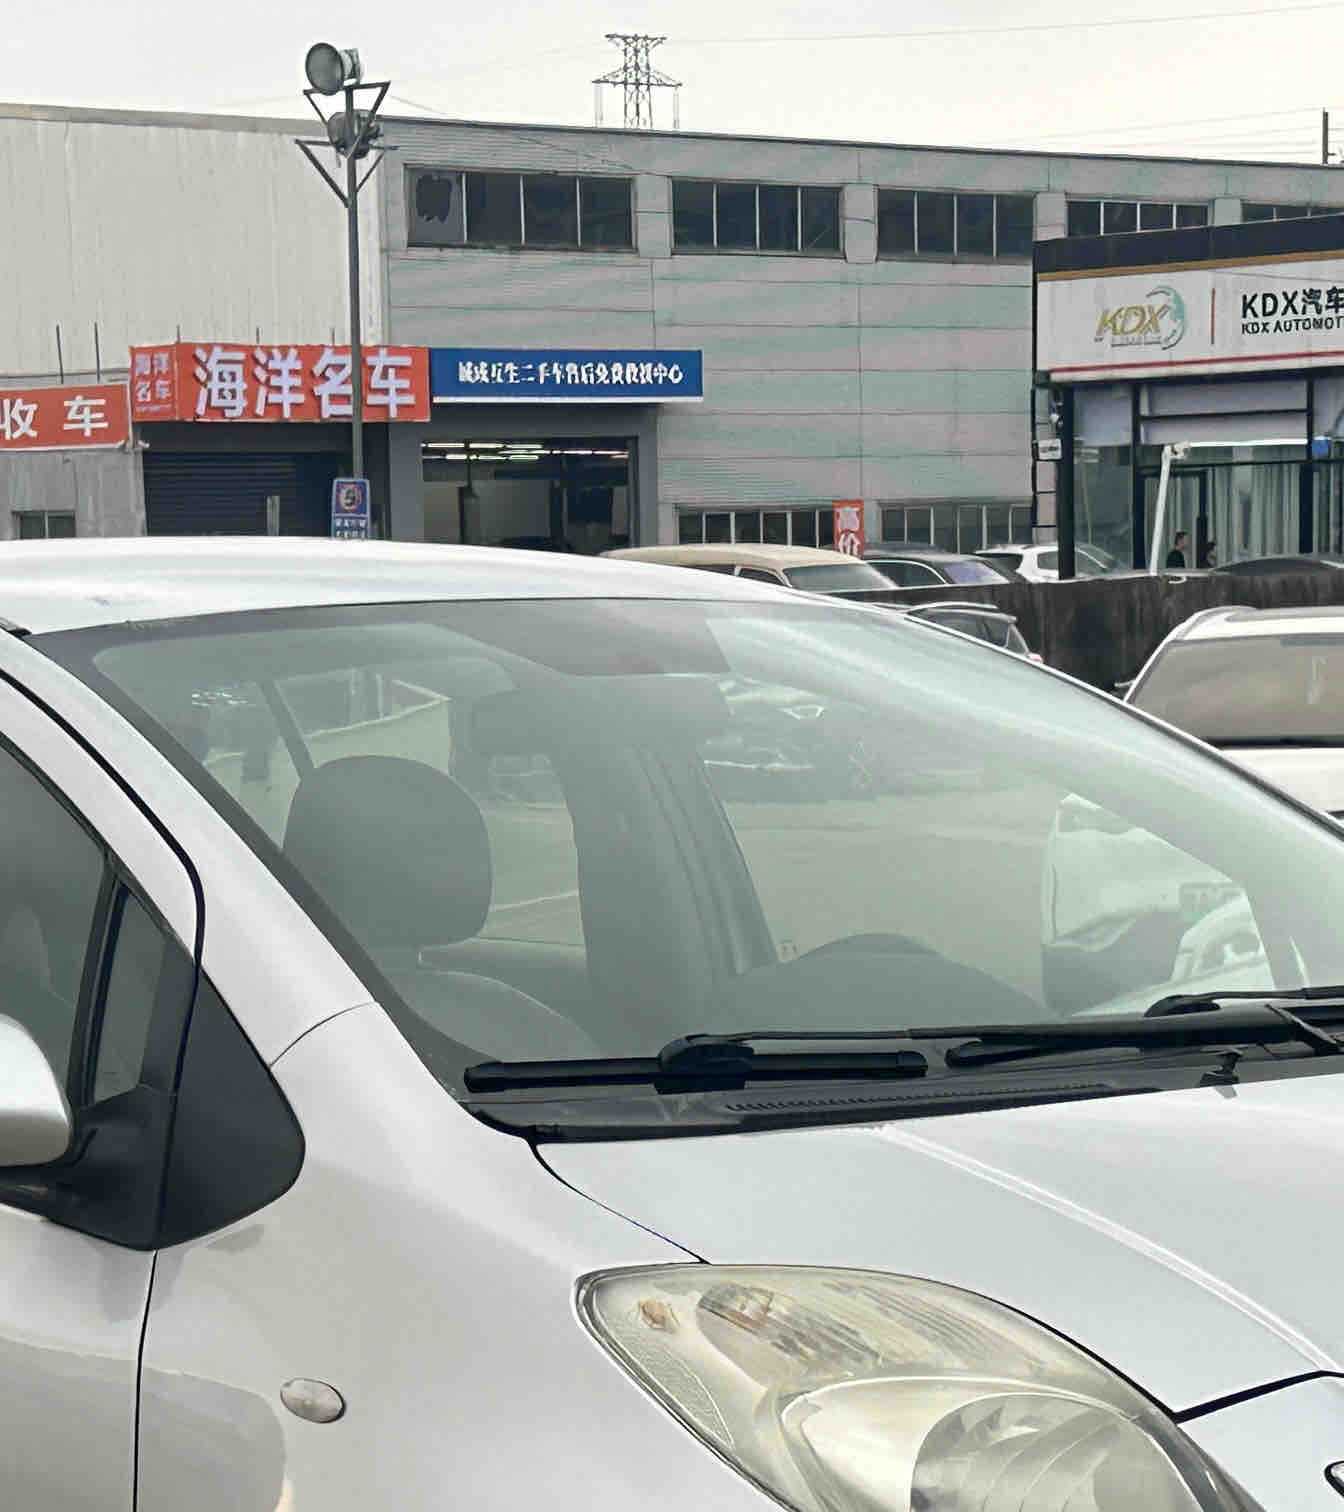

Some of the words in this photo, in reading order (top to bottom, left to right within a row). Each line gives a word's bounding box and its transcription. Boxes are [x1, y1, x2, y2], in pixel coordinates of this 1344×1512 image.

[1095, 304, 1169, 337] KDX
[1241, 321, 1269, 335] KDX
[194, 346, 417, 418] 海洋名车
